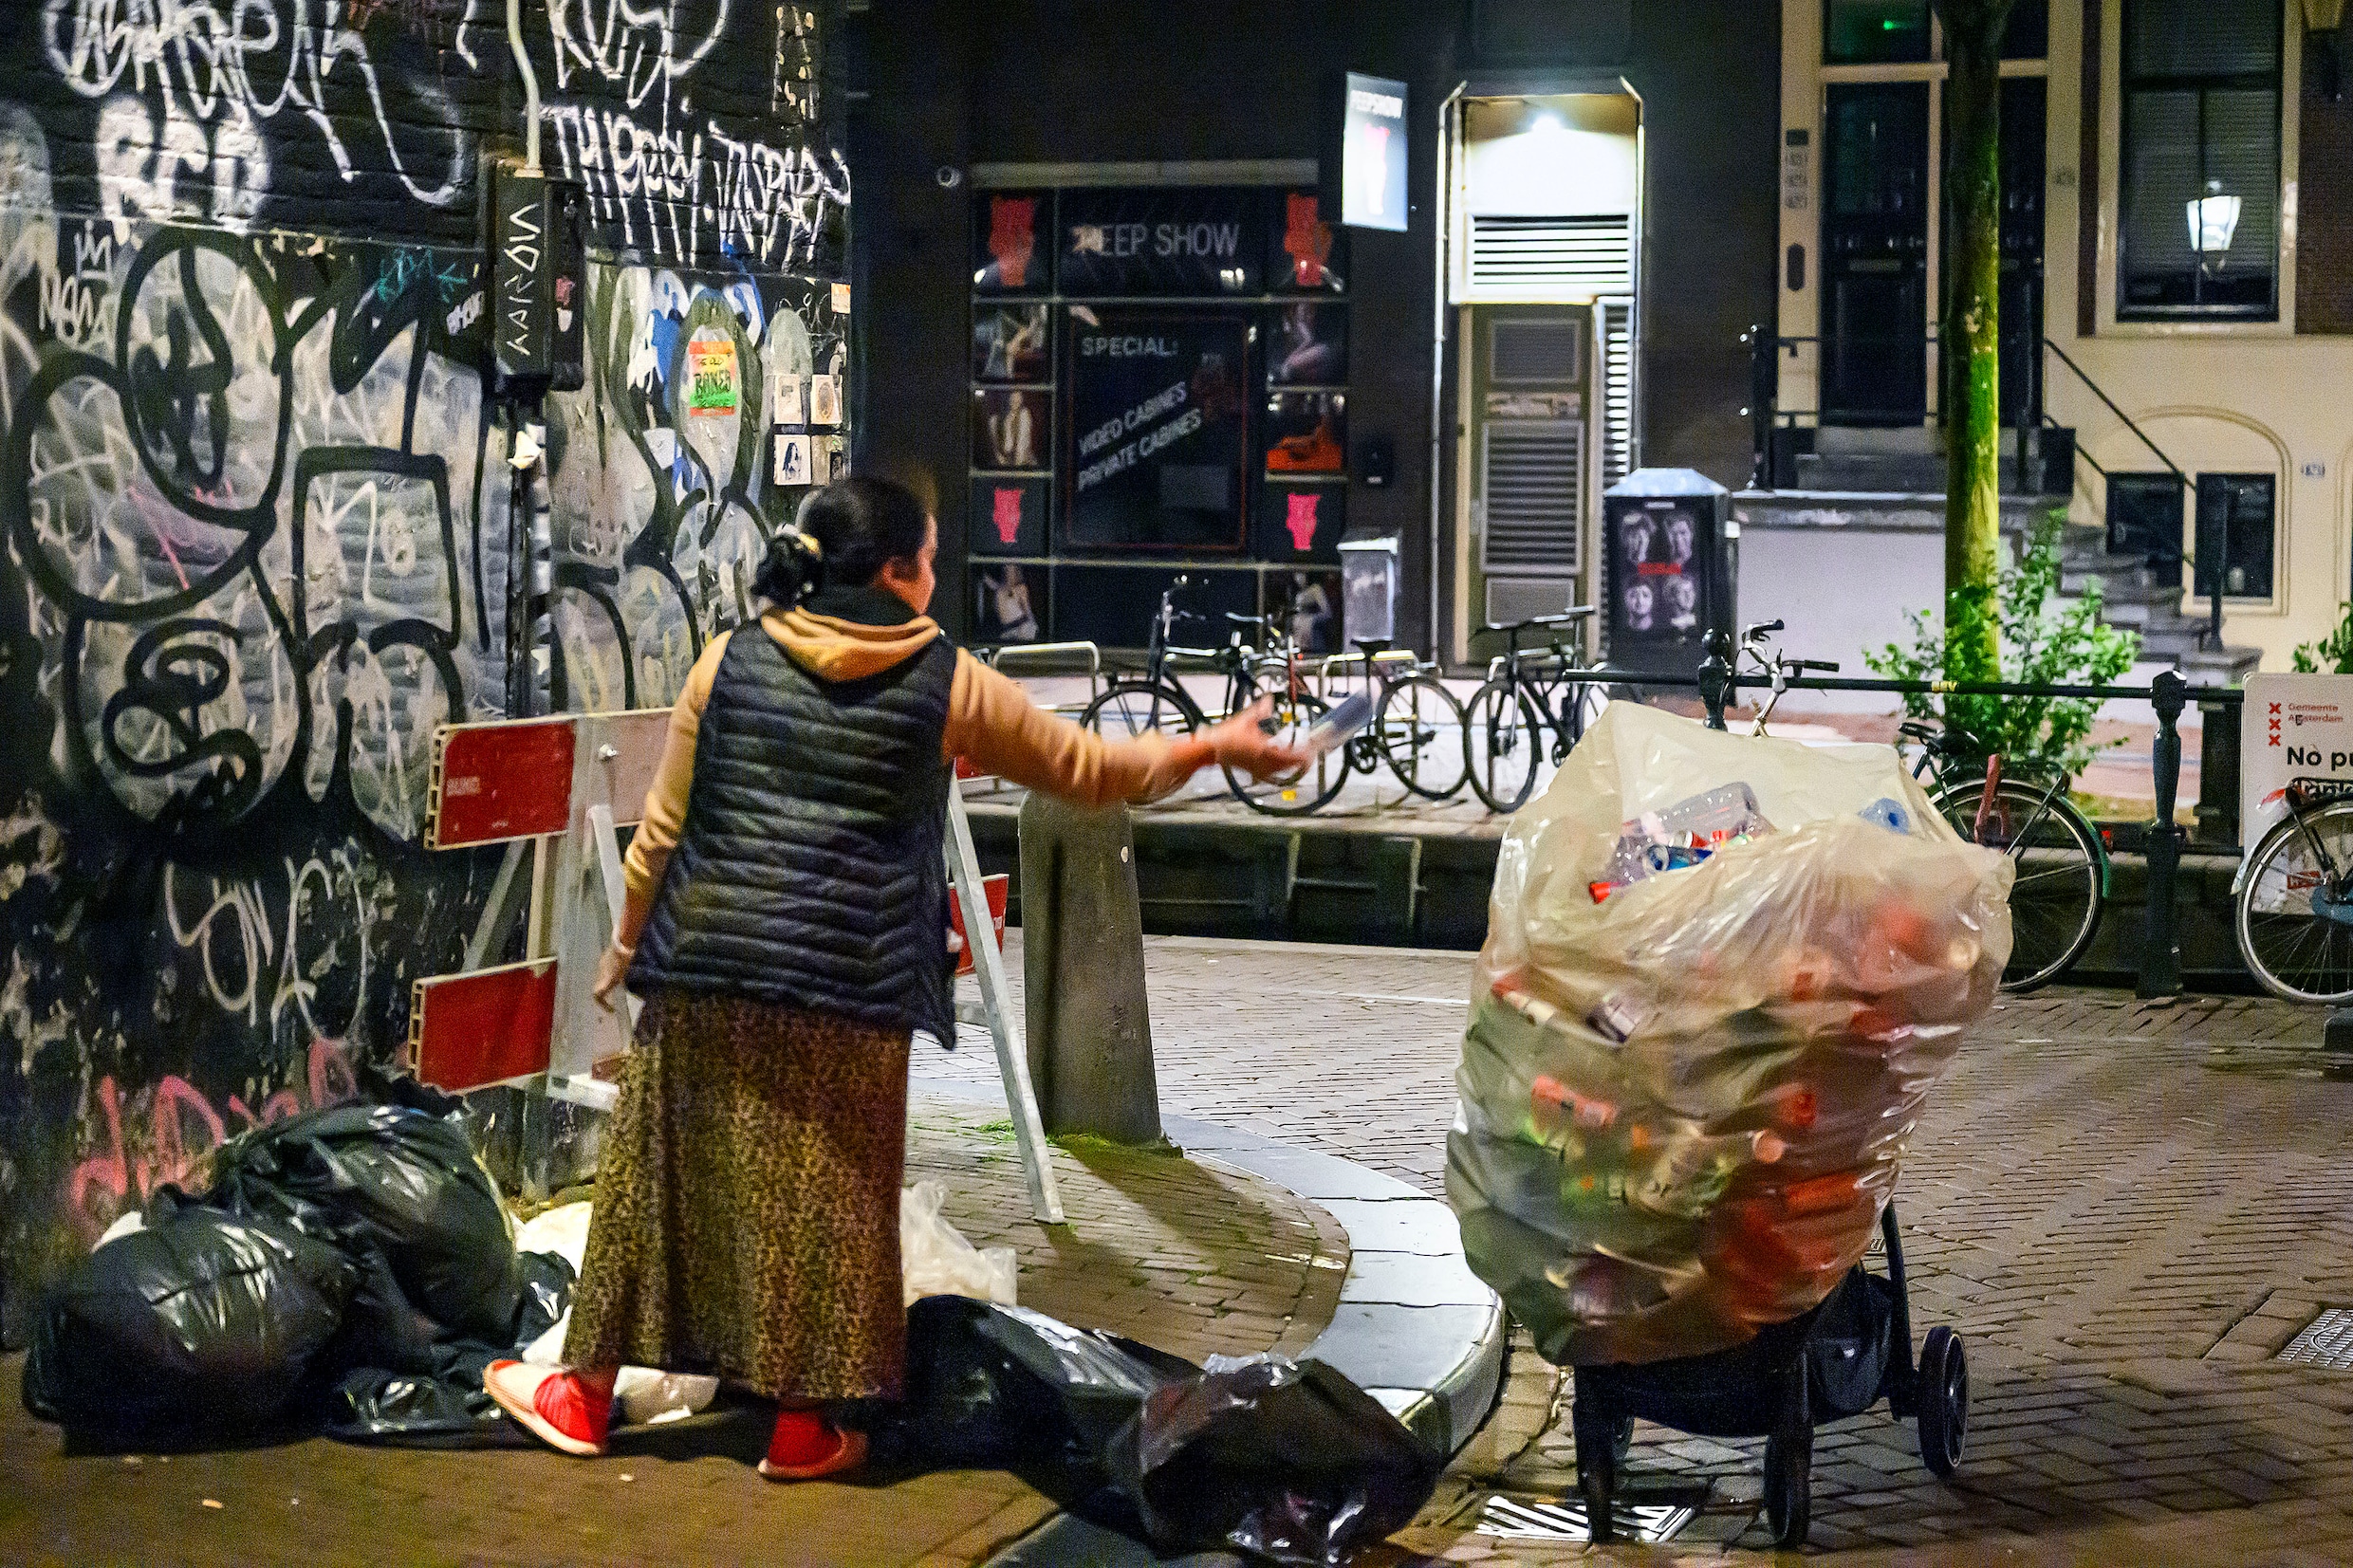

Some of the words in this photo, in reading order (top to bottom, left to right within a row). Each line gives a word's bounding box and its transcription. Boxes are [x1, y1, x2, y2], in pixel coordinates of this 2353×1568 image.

[1079, 223, 1149, 257] EEP
[1155, 223, 1240, 257] SHOW
[1078, 417, 1123, 456] VIDEO
[1124, 381, 1187, 431] CABINES
[1078, 442, 1138, 492] PRIVATE
[1139, 408, 1202, 457] CABINES
[2288, 703, 2339, 713] Gemeente
[2287, 747, 2322, 766] No
[2331, 751, 2353, 771] p
